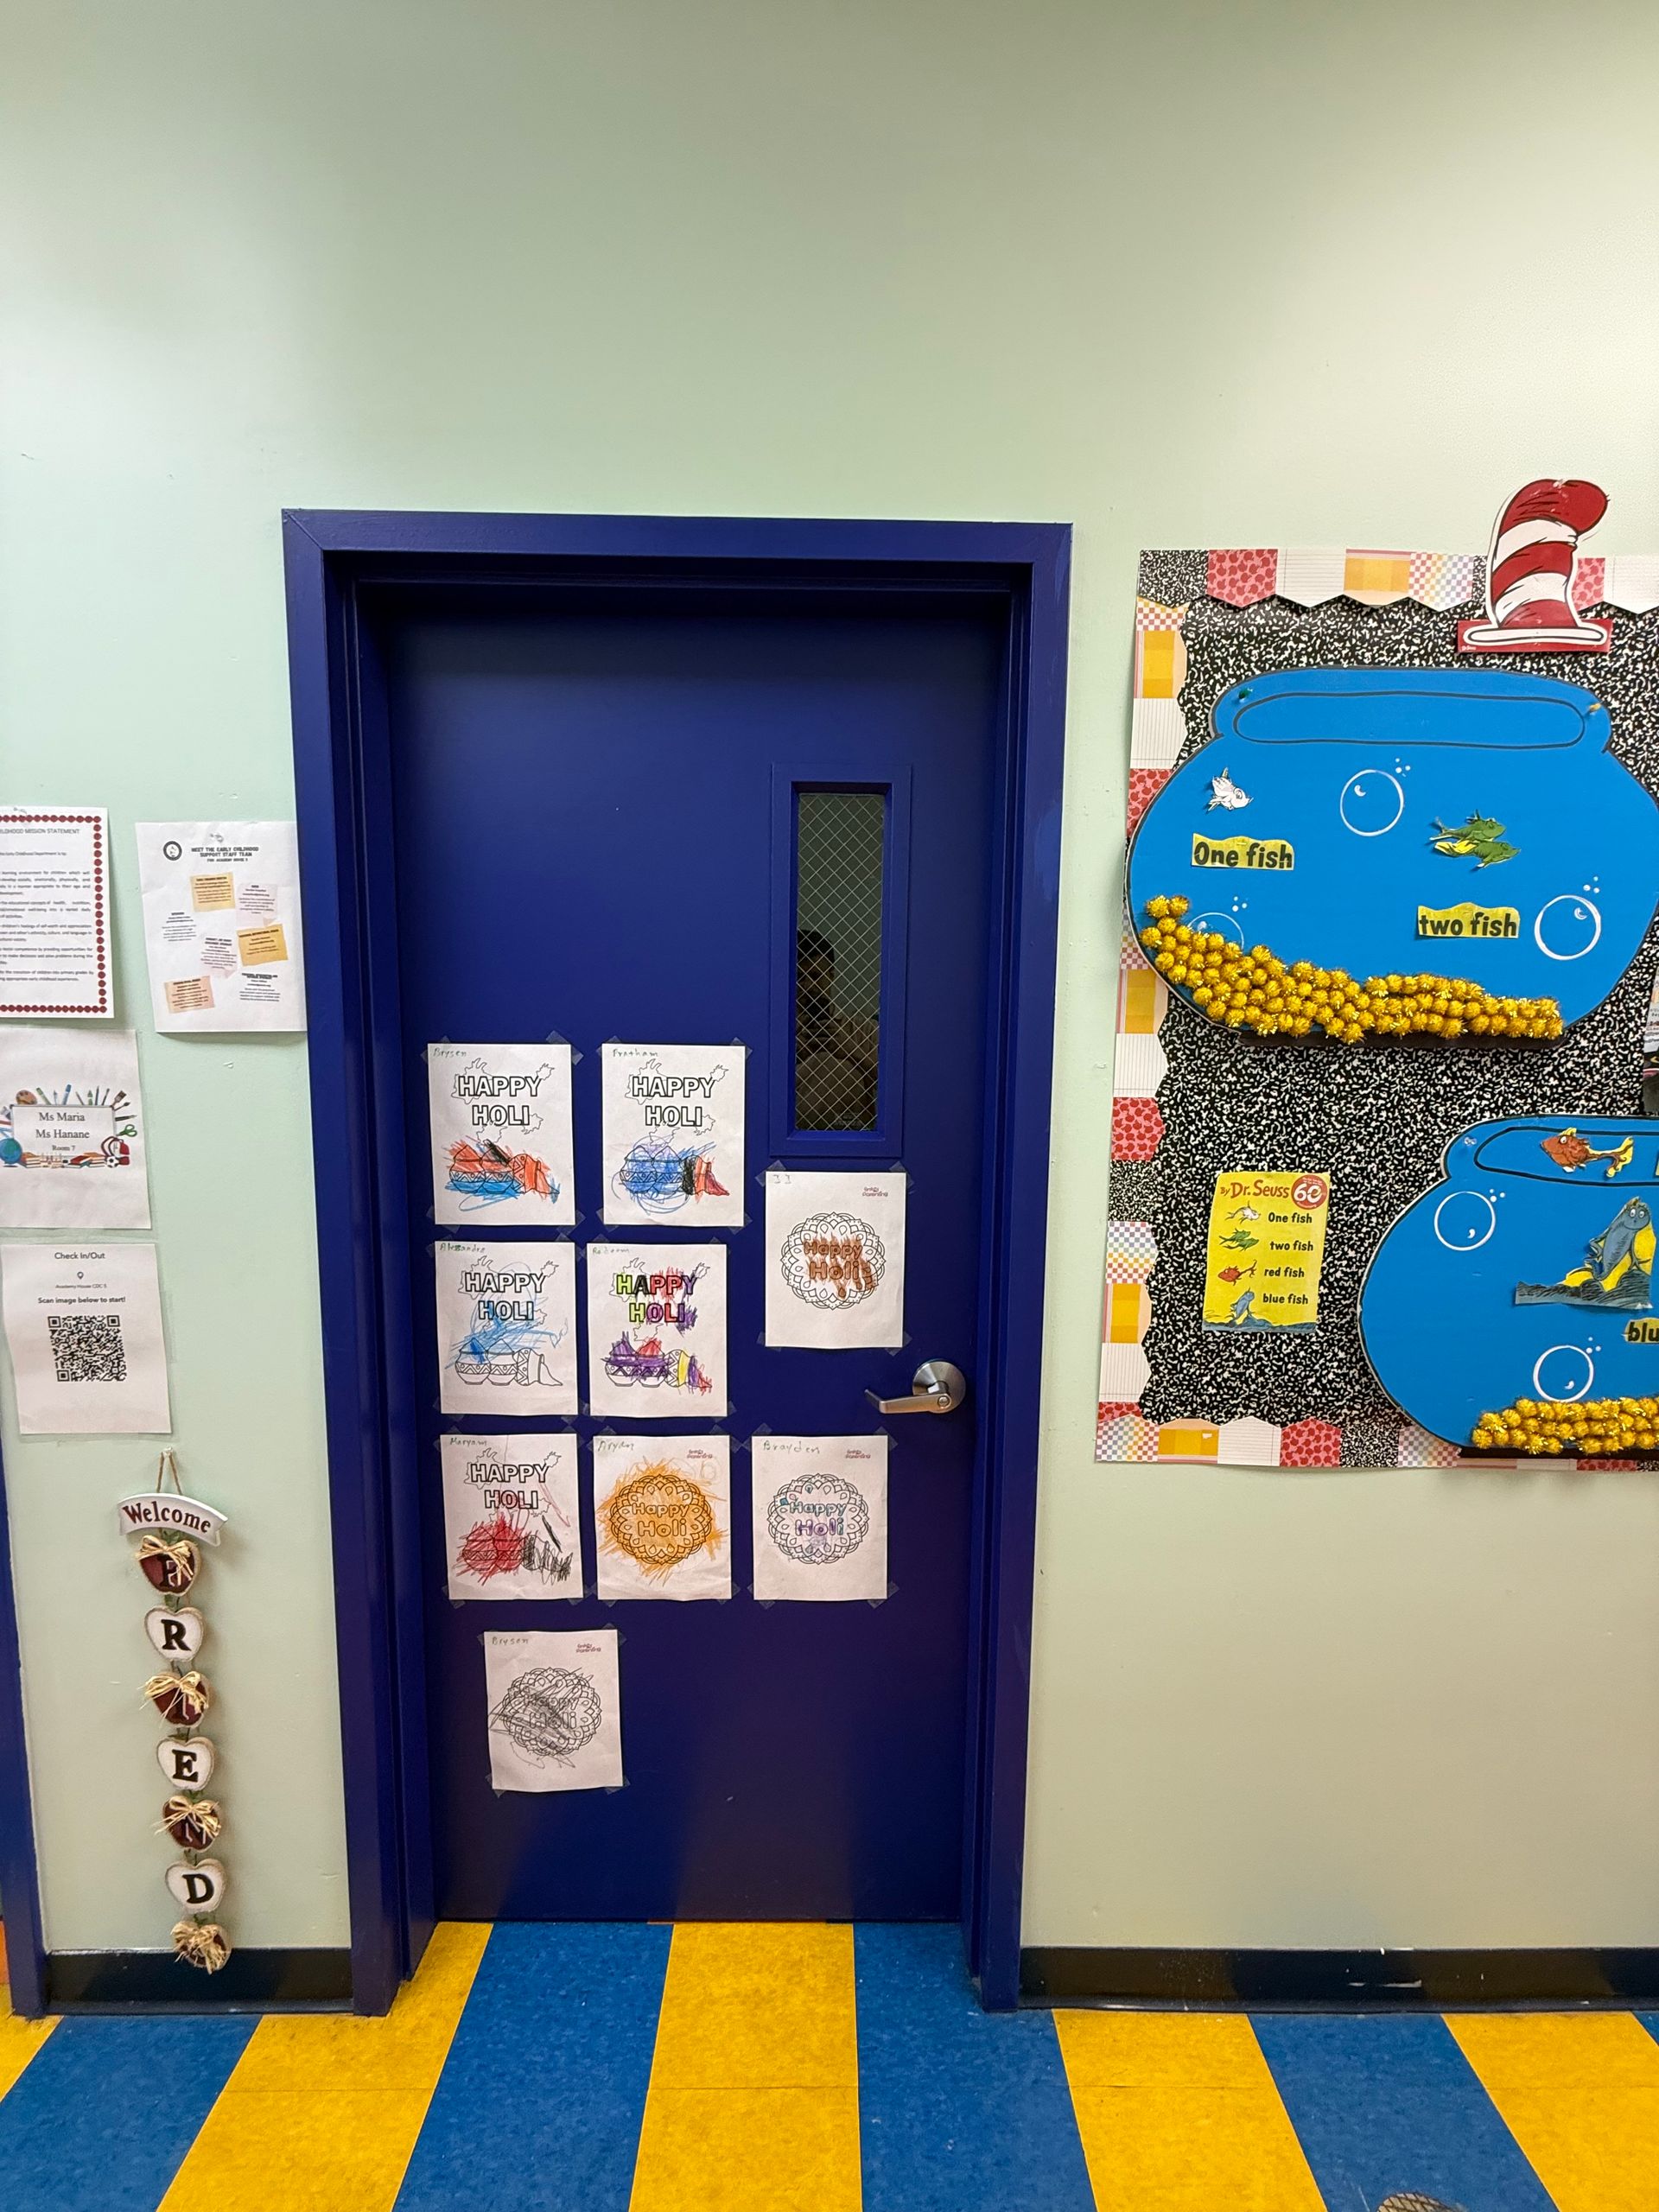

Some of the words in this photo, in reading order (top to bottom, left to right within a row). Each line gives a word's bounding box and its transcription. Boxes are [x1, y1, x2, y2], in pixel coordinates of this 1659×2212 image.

[1194, 842, 1239, 868] One
[1246, 842, 1293, 868] fish
[1419, 912, 1464, 937] two
[1470, 912, 1517, 937] fish
[458, 1075, 543, 1097] HAPPY
[632, 1076, 716, 1098] HAPPY
[39, 1112, 54, 1122] Ms
[57, 1112, 86, 1122] Maria
[472, 1104, 531, 1127] HOLI
[645, 1105, 703, 1128] HOLI
[35, 1128, 51, 1139] Ms
[54, 1128, 90, 1139] Hanane
[1219, 1185, 1230, 1197] By
[1230, 1182, 1251, 1199] Dr.
[1253, 1179, 1290, 1199] Seuss
[1294, 1183, 1322, 1204] 60
[1268, 1212, 1288, 1224] One
[1291, 1212, 1313, 1224] fish
[804, 1241, 863, 1260] Happy
[1270, 1241, 1291, 1251] two
[1293, 1241, 1314, 1251] fish
[810, 1260, 860, 1281] Holi
[1264, 1267, 1281, 1277] red
[1283, 1267, 1305, 1278] fish
[465, 1272, 547, 1294] HAPPY
[616, 1274, 698, 1295] HAPPY
[1262, 1294, 1285, 1304] blue
[1287, 1294, 1309, 1305] fish
[478, 1300, 535, 1321] HOLI
[629, 1302, 686, 1323] HOLI
[470, 1463, 550, 1484] HAPPY
[484, 1490, 539, 1510] HOLI
[632, 1502, 690, 1518] Happy
[789, 1501, 848, 1517] Happy
[122, 1500, 212, 1533] Welcome
[794, 1516, 844, 1536] Holi
[637, 1517, 688, 1537] Holi
[530, 1711, 577, 1730] Holi
